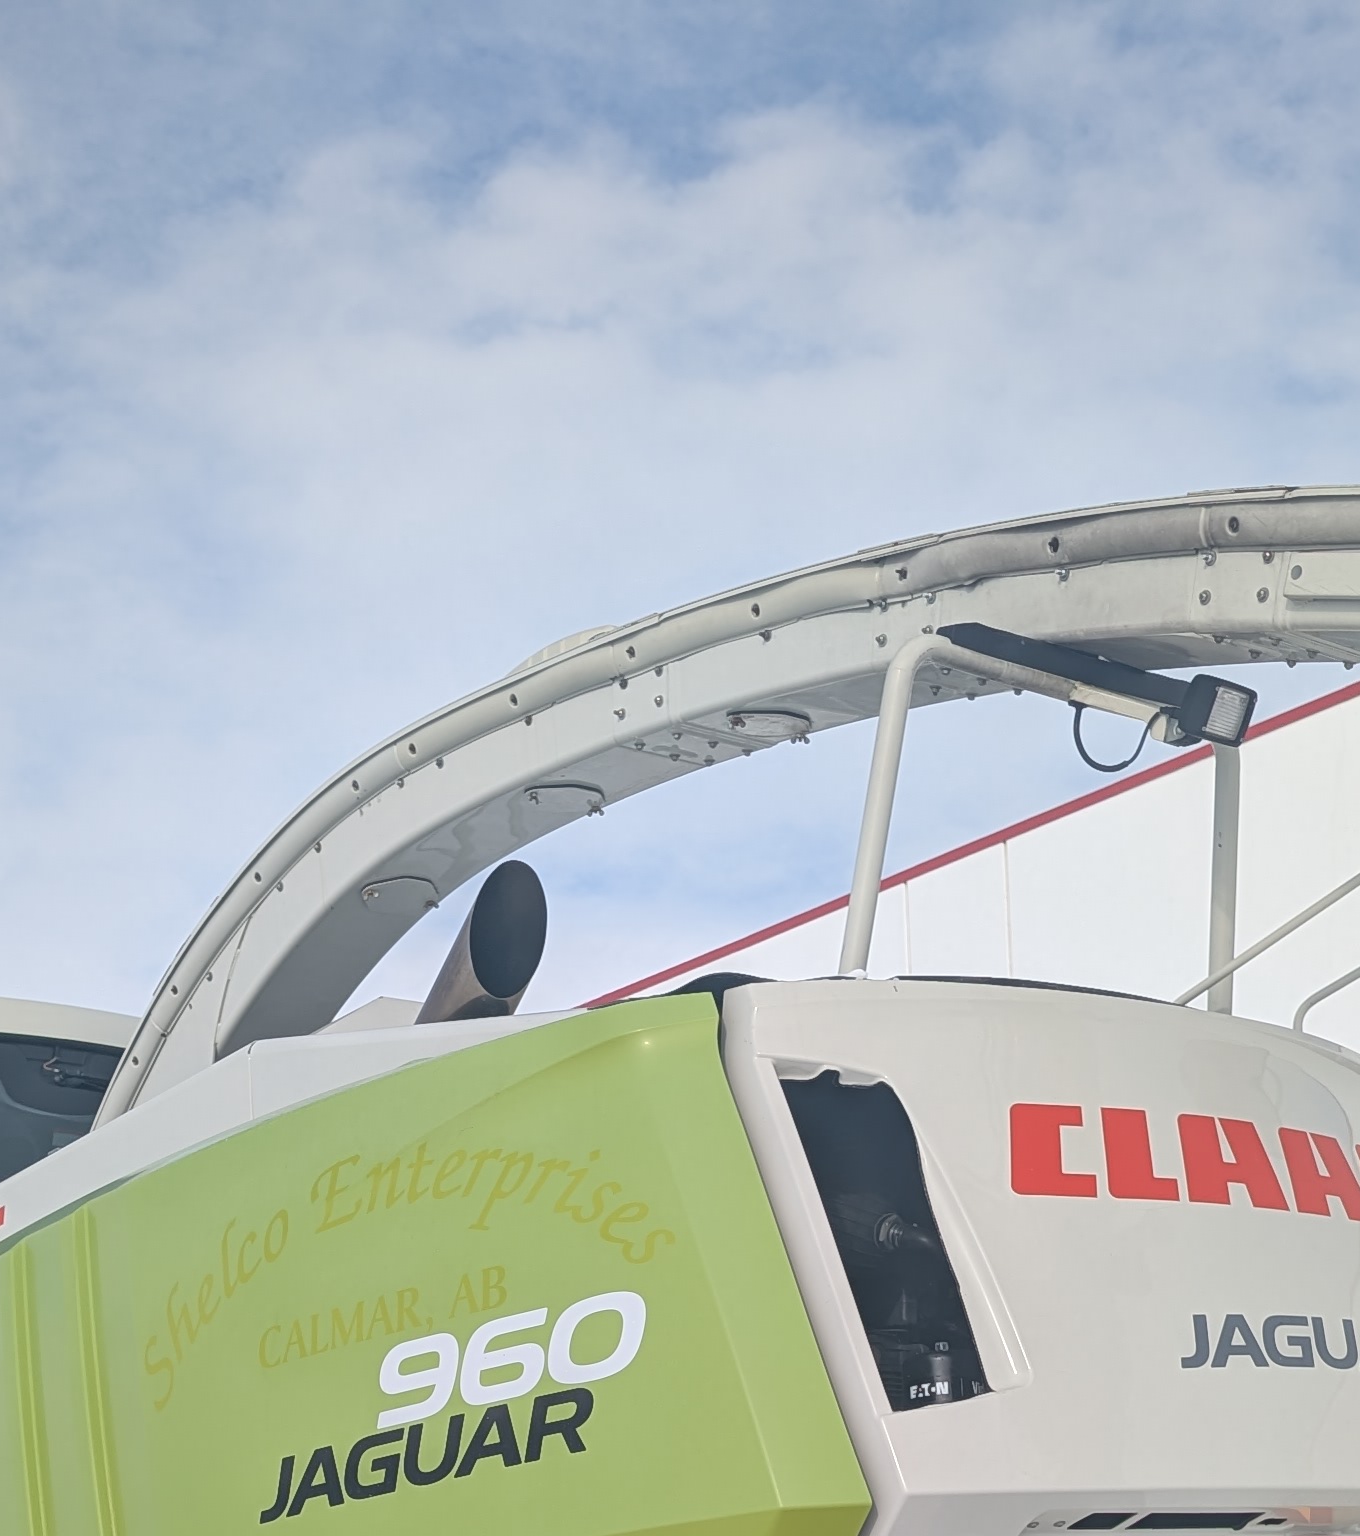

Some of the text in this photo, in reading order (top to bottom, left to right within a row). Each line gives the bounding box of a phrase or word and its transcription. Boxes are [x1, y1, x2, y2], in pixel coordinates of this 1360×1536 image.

[143, 1141, 676, 1411] Shelco Enterprises
[448, 1265, 509, 1319] AB
[376, 1290, 647, 1430] 960
[259, 1387, 594, 1525] JAGUAR
